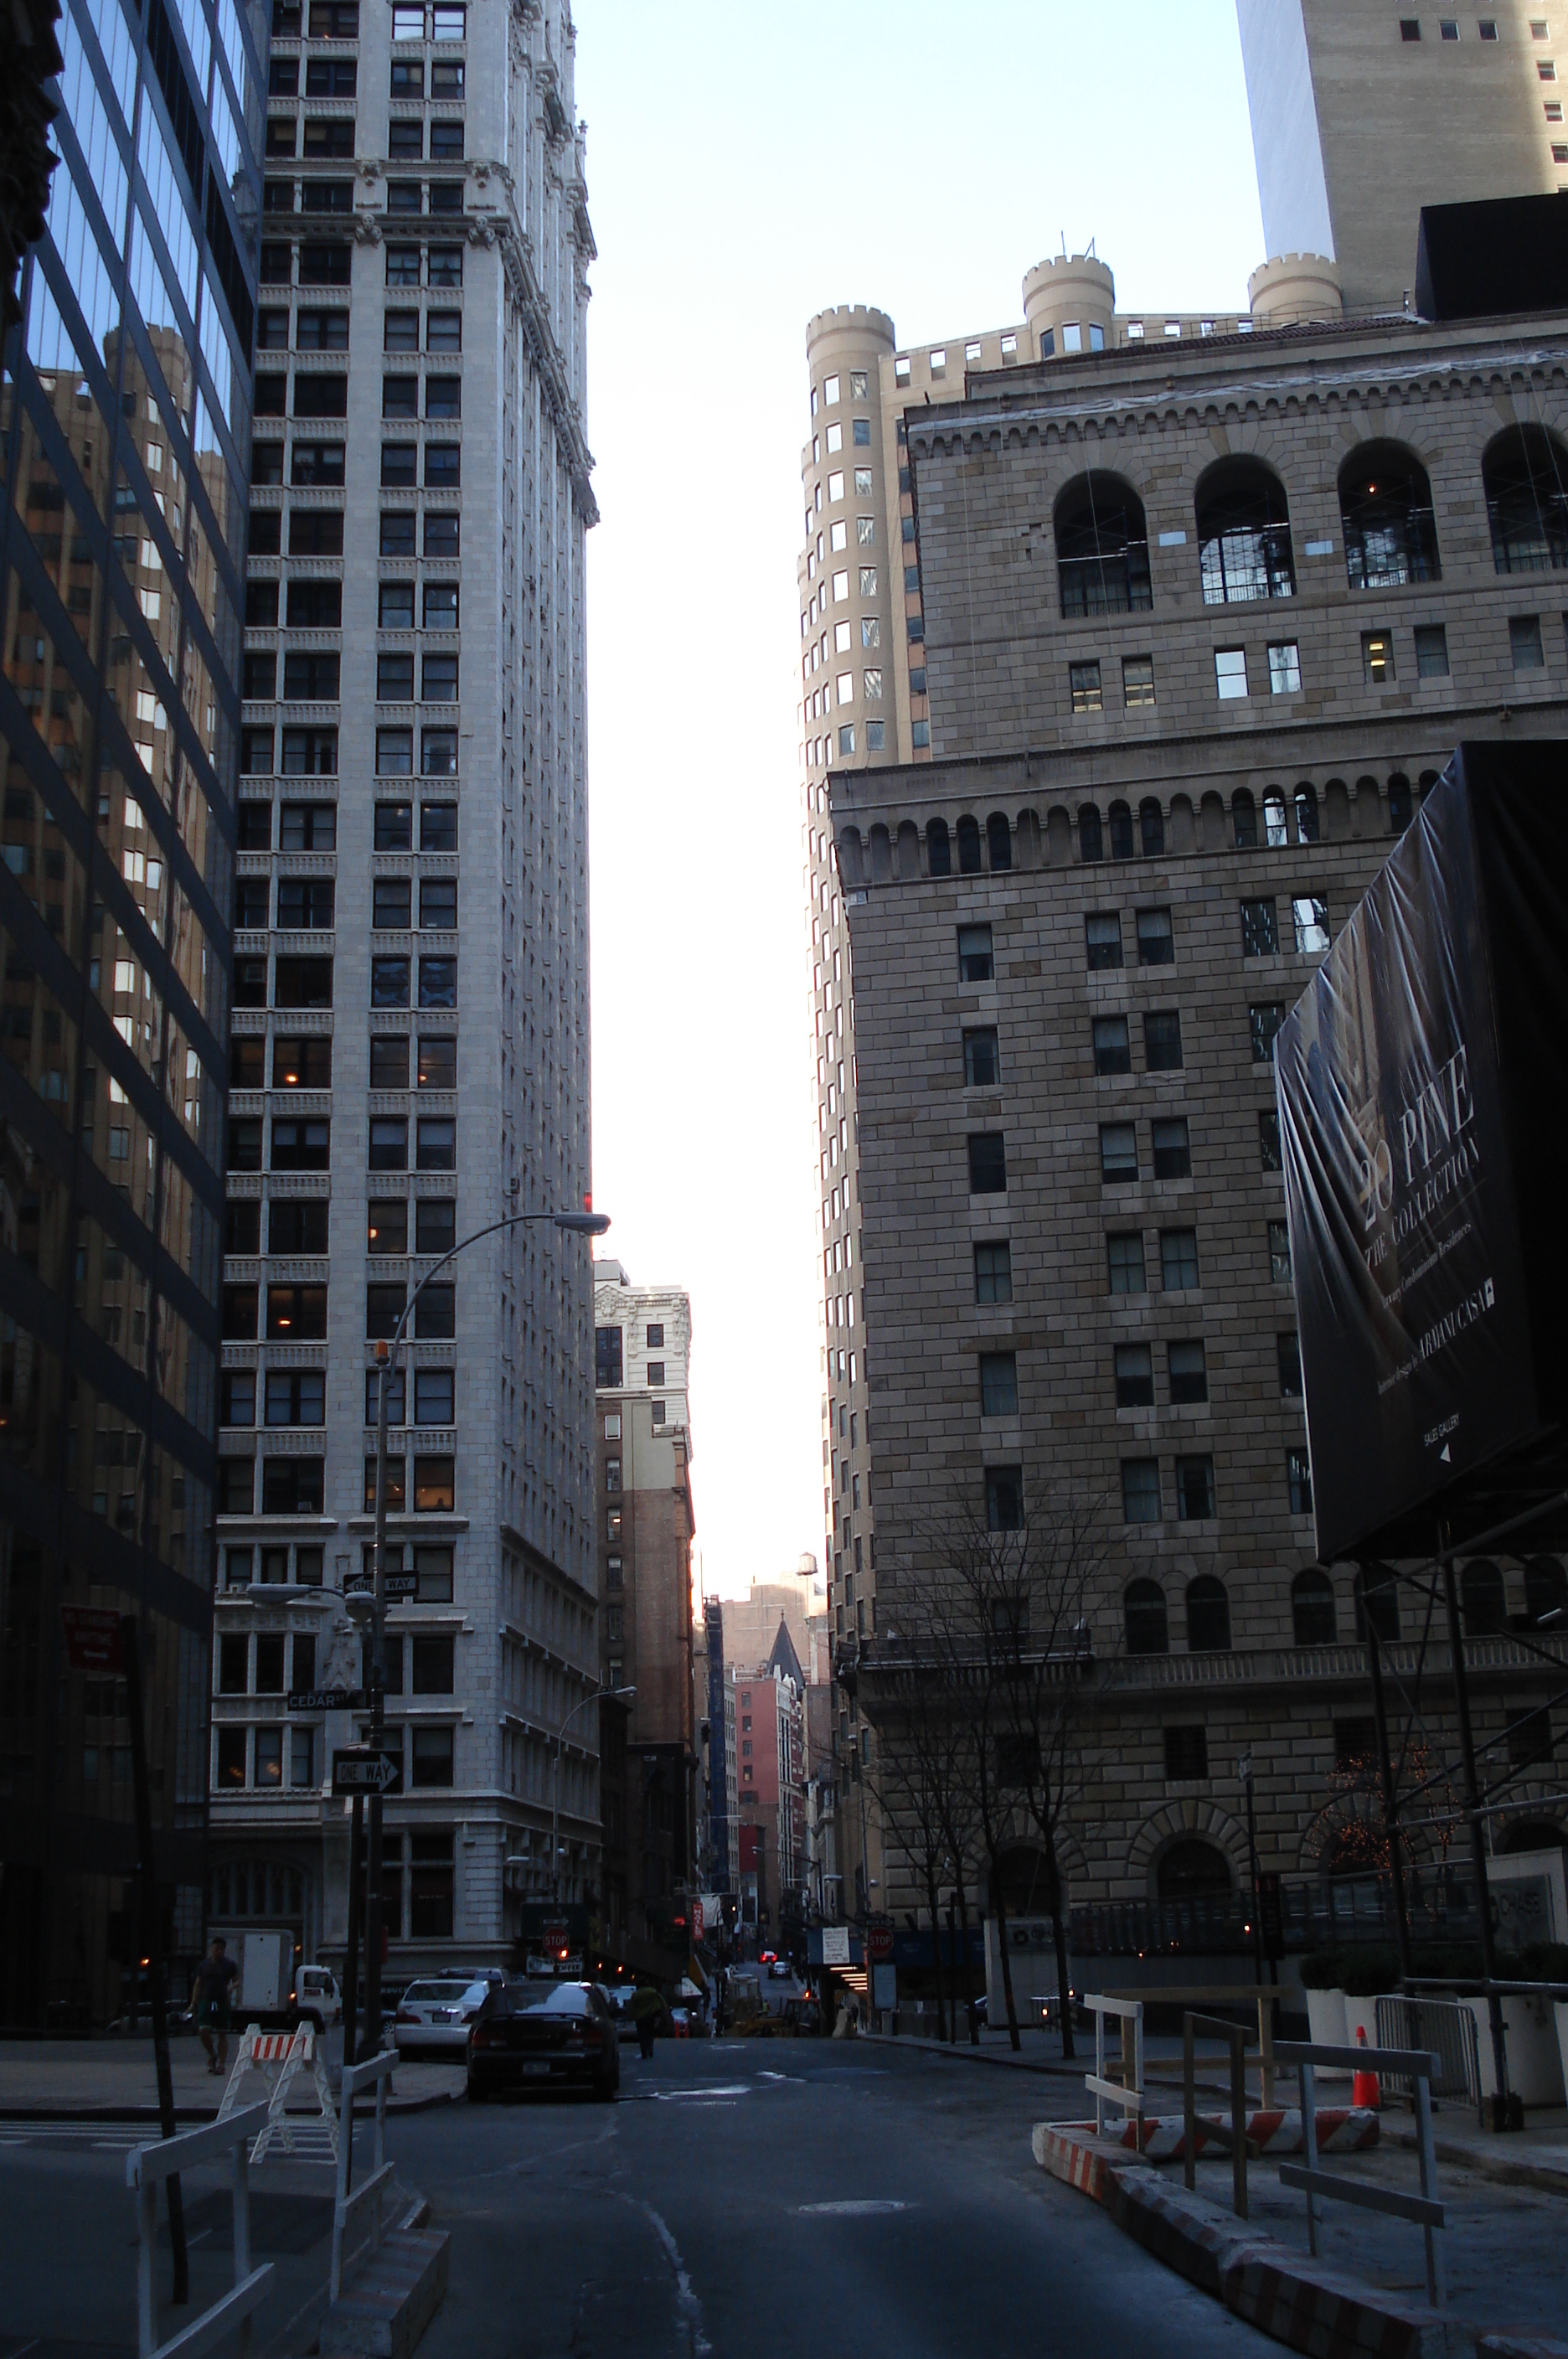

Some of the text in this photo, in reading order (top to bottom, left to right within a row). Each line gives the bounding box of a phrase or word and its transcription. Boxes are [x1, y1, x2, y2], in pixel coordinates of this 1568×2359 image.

[1360, 1043, 1474, 1231] 20 PINE
[1364, 1133, 1481, 1272] THE COLLECTION
[1424, 1412, 1460, 1447] SALES GALLERY
[353, 1579, 410, 1592] ONE WAY
[290, 1695, 335, 1707] CEDAR
[341, 1764, 390, 1781] ONE WAY
[1501, 1892, 1541, 1916] CHASE
[545, 1935, 567, 1946] STOP
[869, 1935, 891, 1946] STOP
